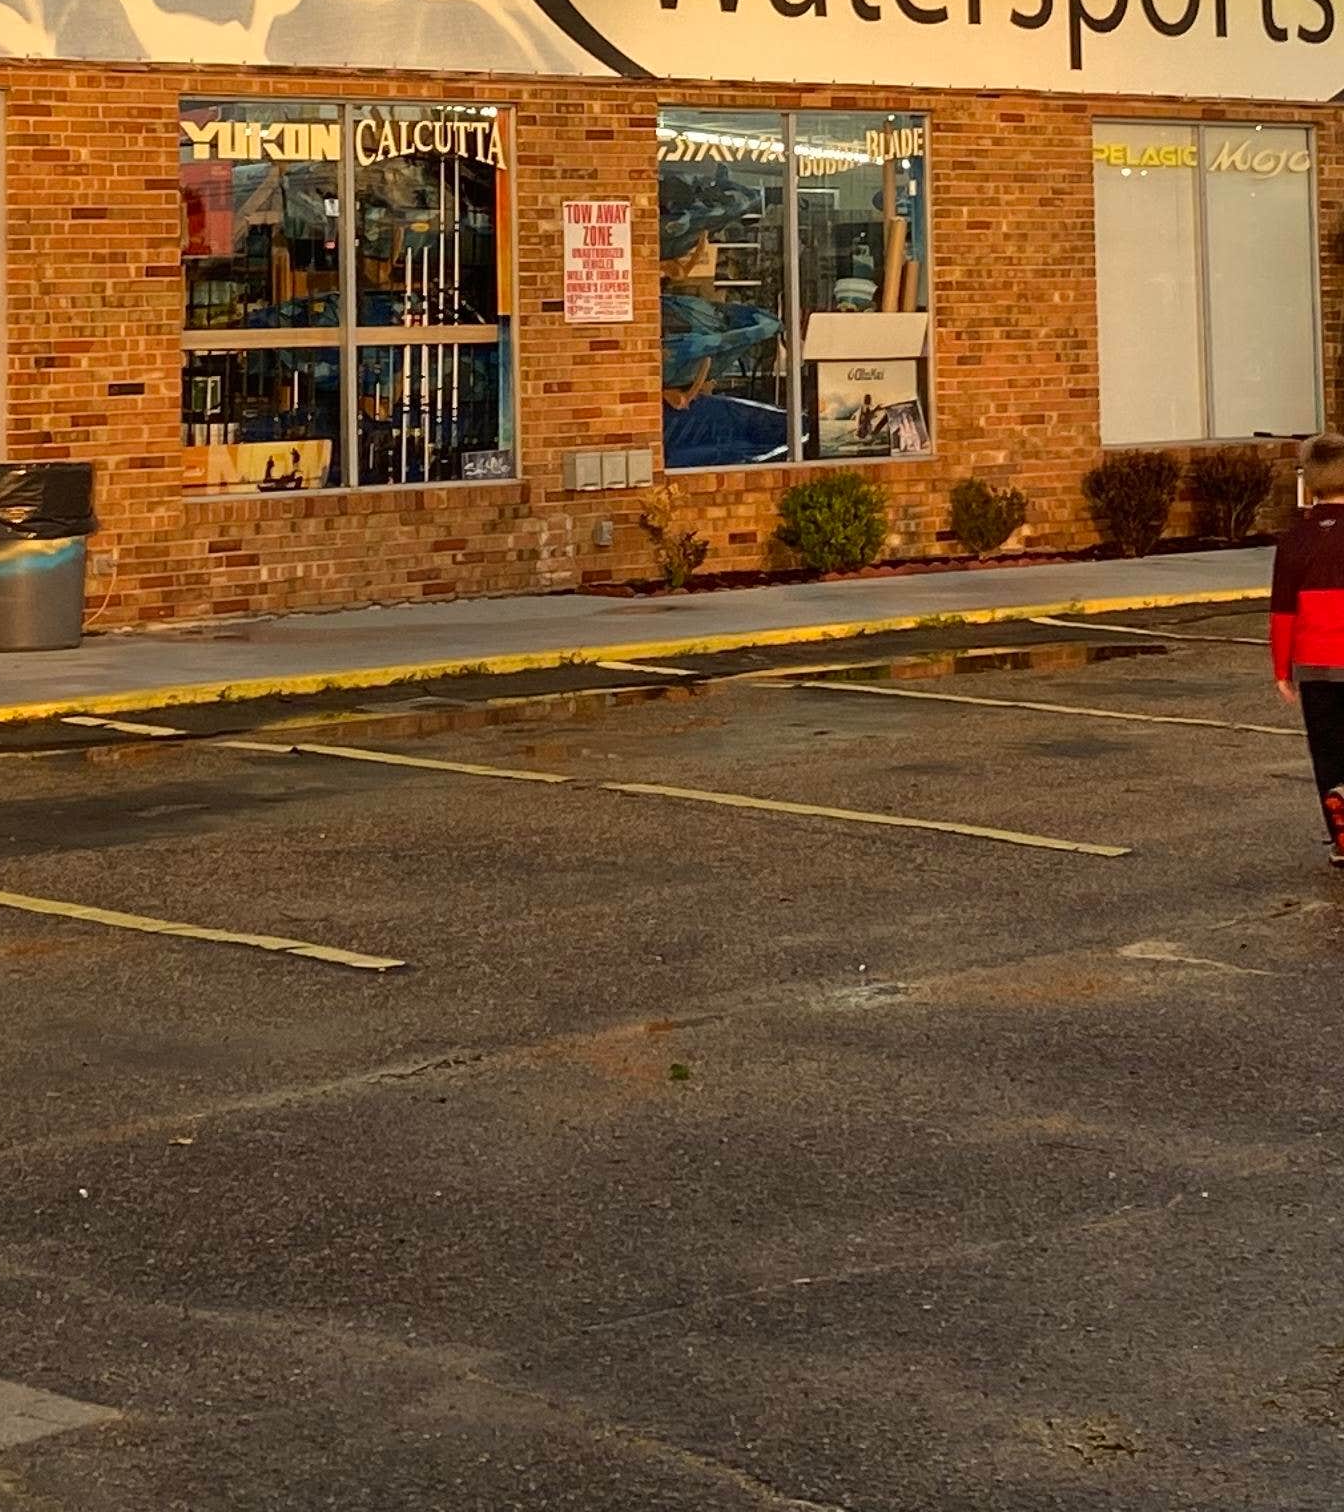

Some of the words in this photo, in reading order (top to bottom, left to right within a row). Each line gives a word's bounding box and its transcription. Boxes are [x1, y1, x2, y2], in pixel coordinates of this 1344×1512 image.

[180, 121, 340, 160] YUKON
[355, 118, 507, 168] CALCUTTA
[867, 128, 924, 160] BLADE
[1093, 144, 1197, 167] PELAGIC
[567, 204, 593, 224] TOW
[596, 204, 628, 224] AWAY
[583, 226, 613, 246] ZONE
